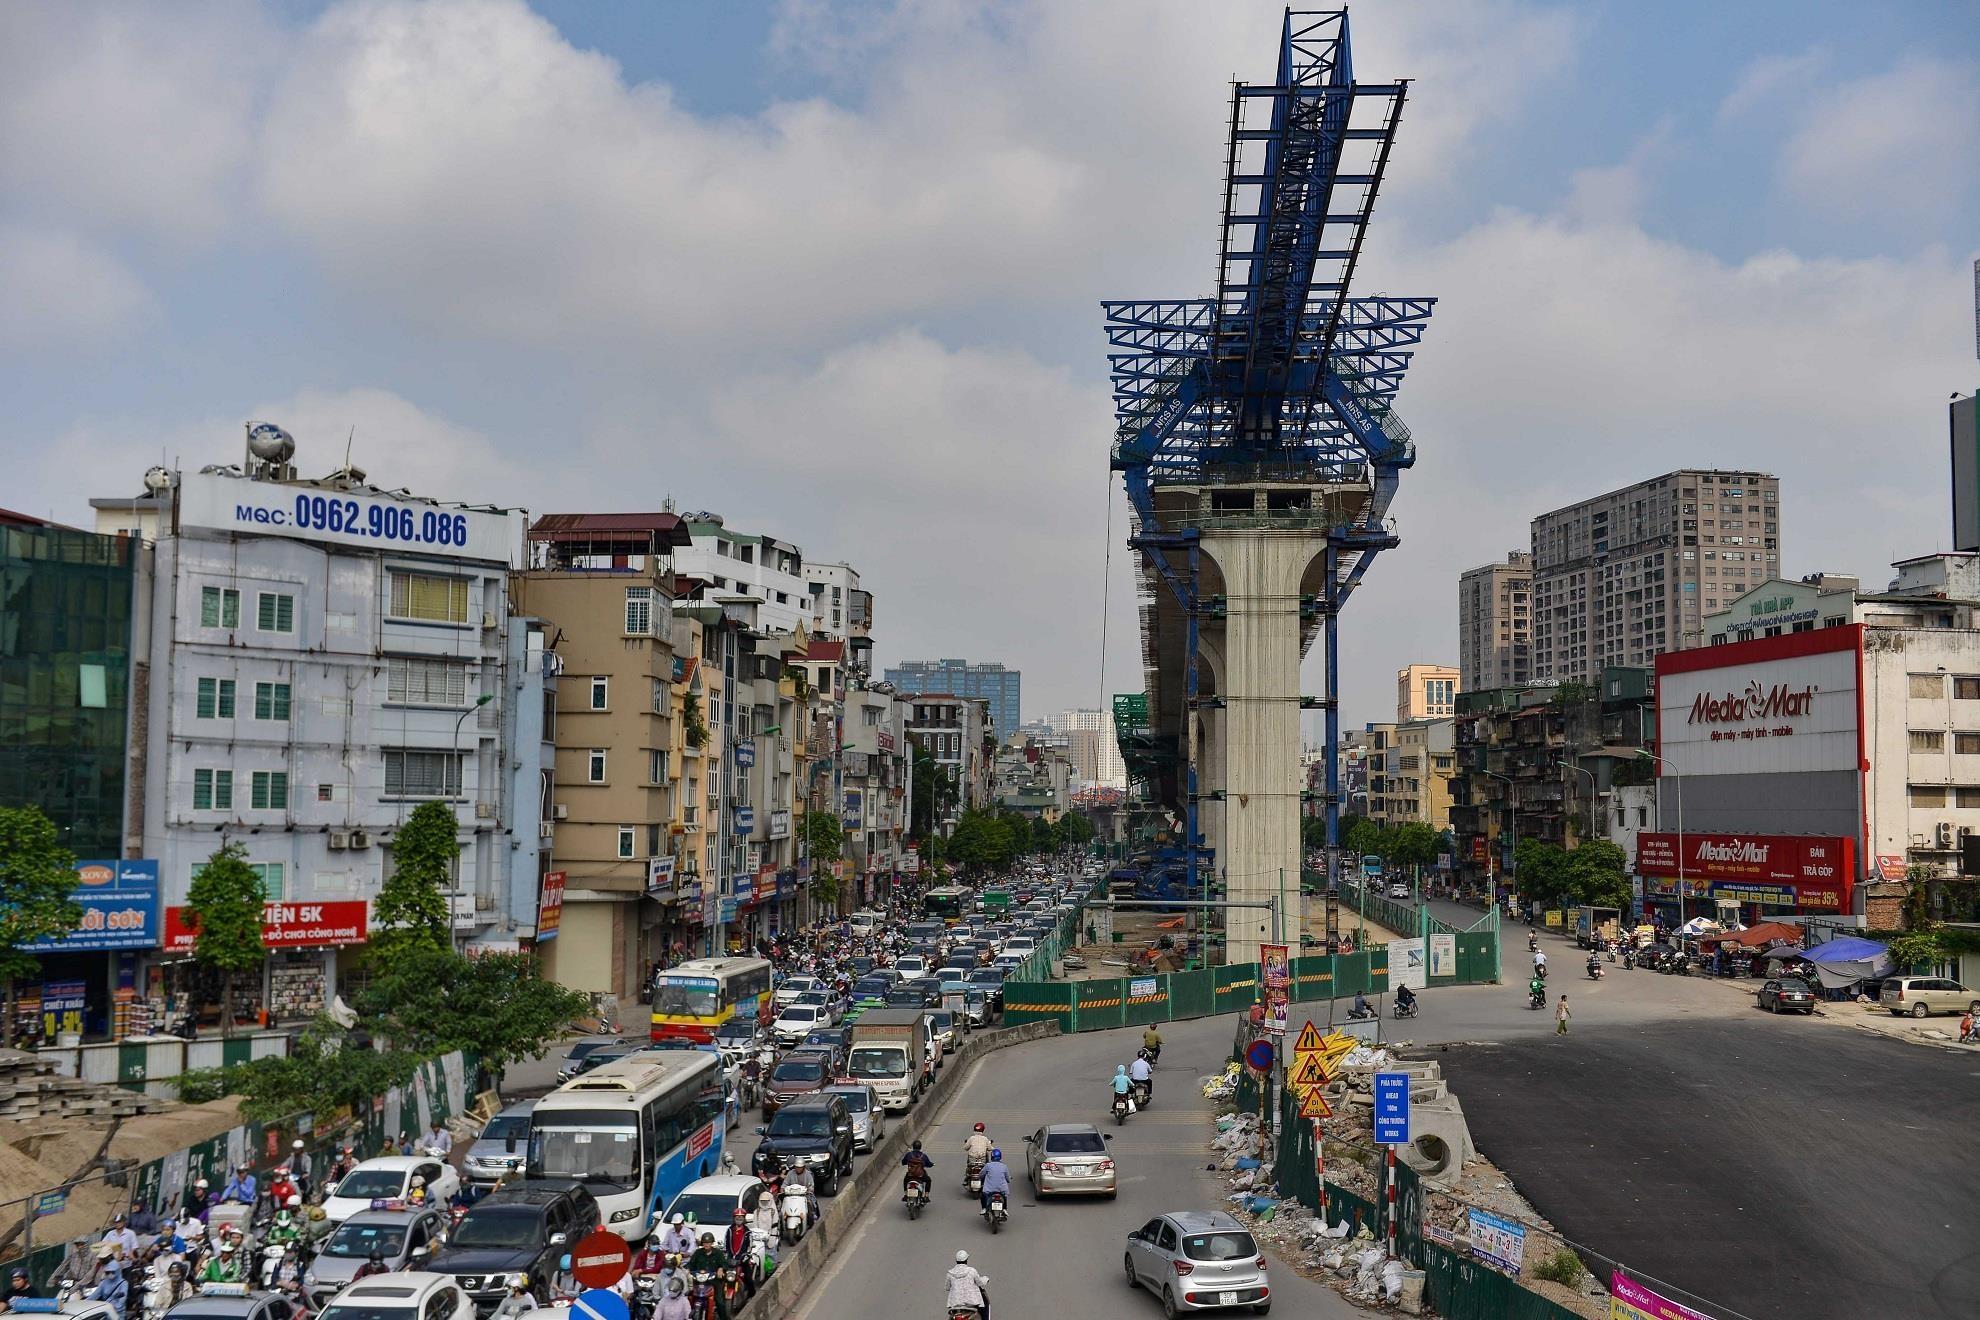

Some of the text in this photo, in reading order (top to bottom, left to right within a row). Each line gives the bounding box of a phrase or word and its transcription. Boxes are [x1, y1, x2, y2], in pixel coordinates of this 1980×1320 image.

[1154, 399, 1181, 429] NRS AS
[1346, 400, 1372, 431] NRS AS
[236, 494, 467, 547] MQC: 0962.906.086
[1688, 683, 1813, 725] Media Mart
[1772, 725, 1793, 737] mobile
[1696, 841, 1732, 861] Media
[1738, 842, 1768, 863] Mart
[80, 871, 109, 880] KOVA
[1818, 864, 1833, 877] GÓP
[1822, 891, 1839, 906] 35%
[108, 907, 145, 929] SƠN
[262, 903, 323, 925] IỆN 5K
[284, 929, 306, 939] CHƠI
[308, 926, 333, 939] CÔNG
[334, 926, 357, 938] NGHỆ
